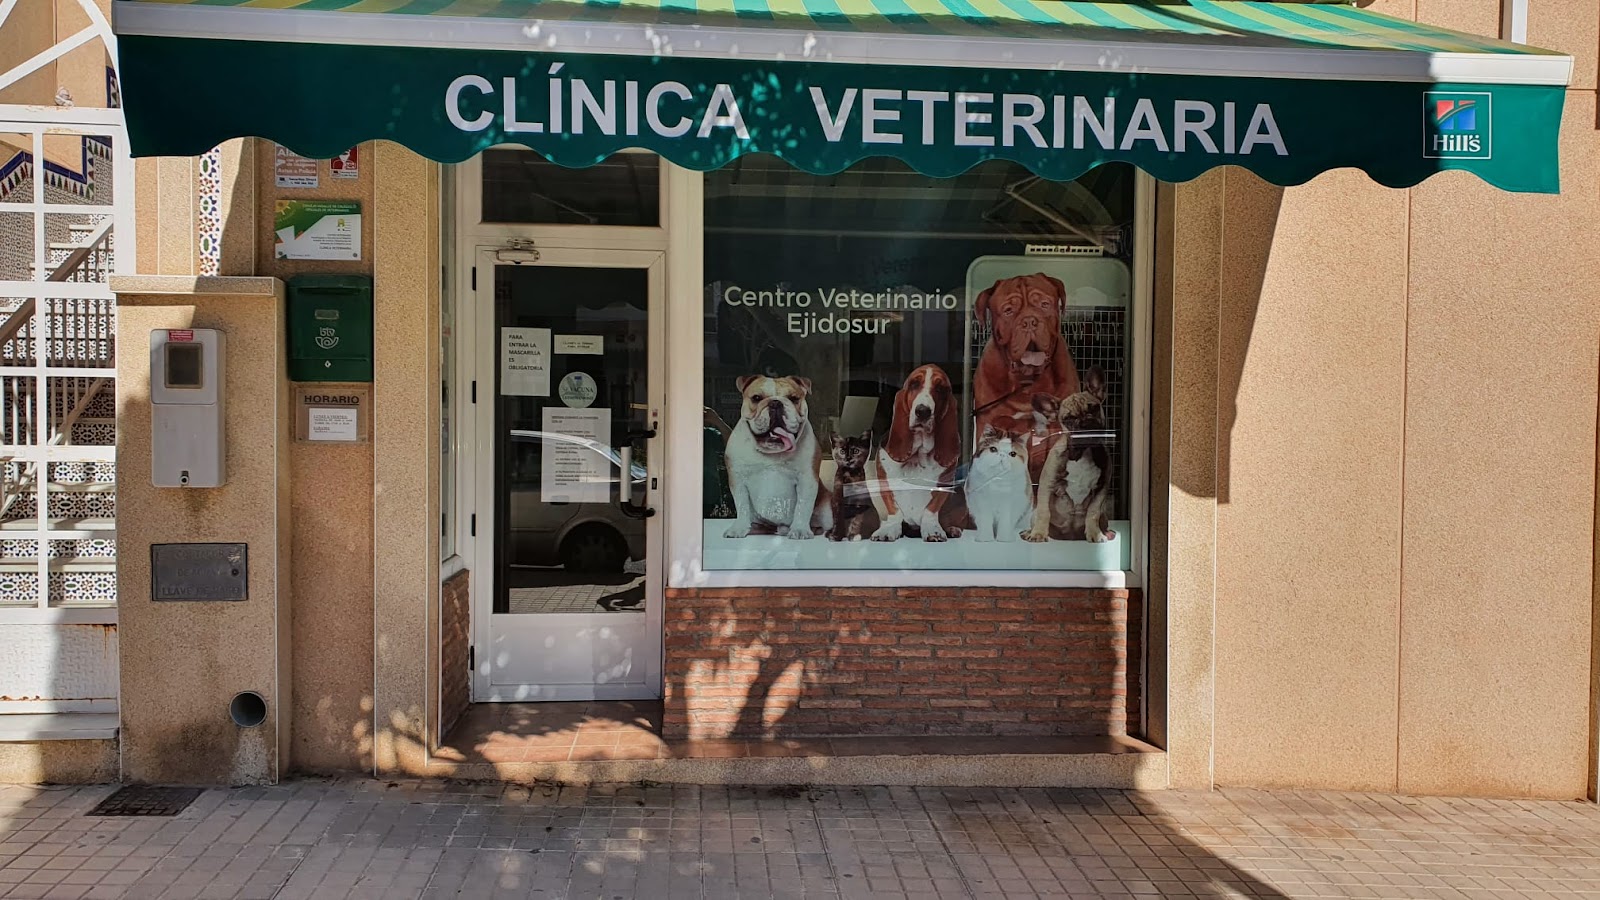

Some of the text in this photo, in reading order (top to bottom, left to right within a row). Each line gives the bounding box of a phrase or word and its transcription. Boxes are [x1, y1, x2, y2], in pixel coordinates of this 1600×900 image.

[444, 62, 1289, 156] CLÍNICA VETERINARIA
[1433, 134, 1481, 152] Hill's
[724, 286, 958, 310] Centro Veterinario
[787, 312, 890, 338] Ejidosur
[304, 395, 360, 404] HORARIO
